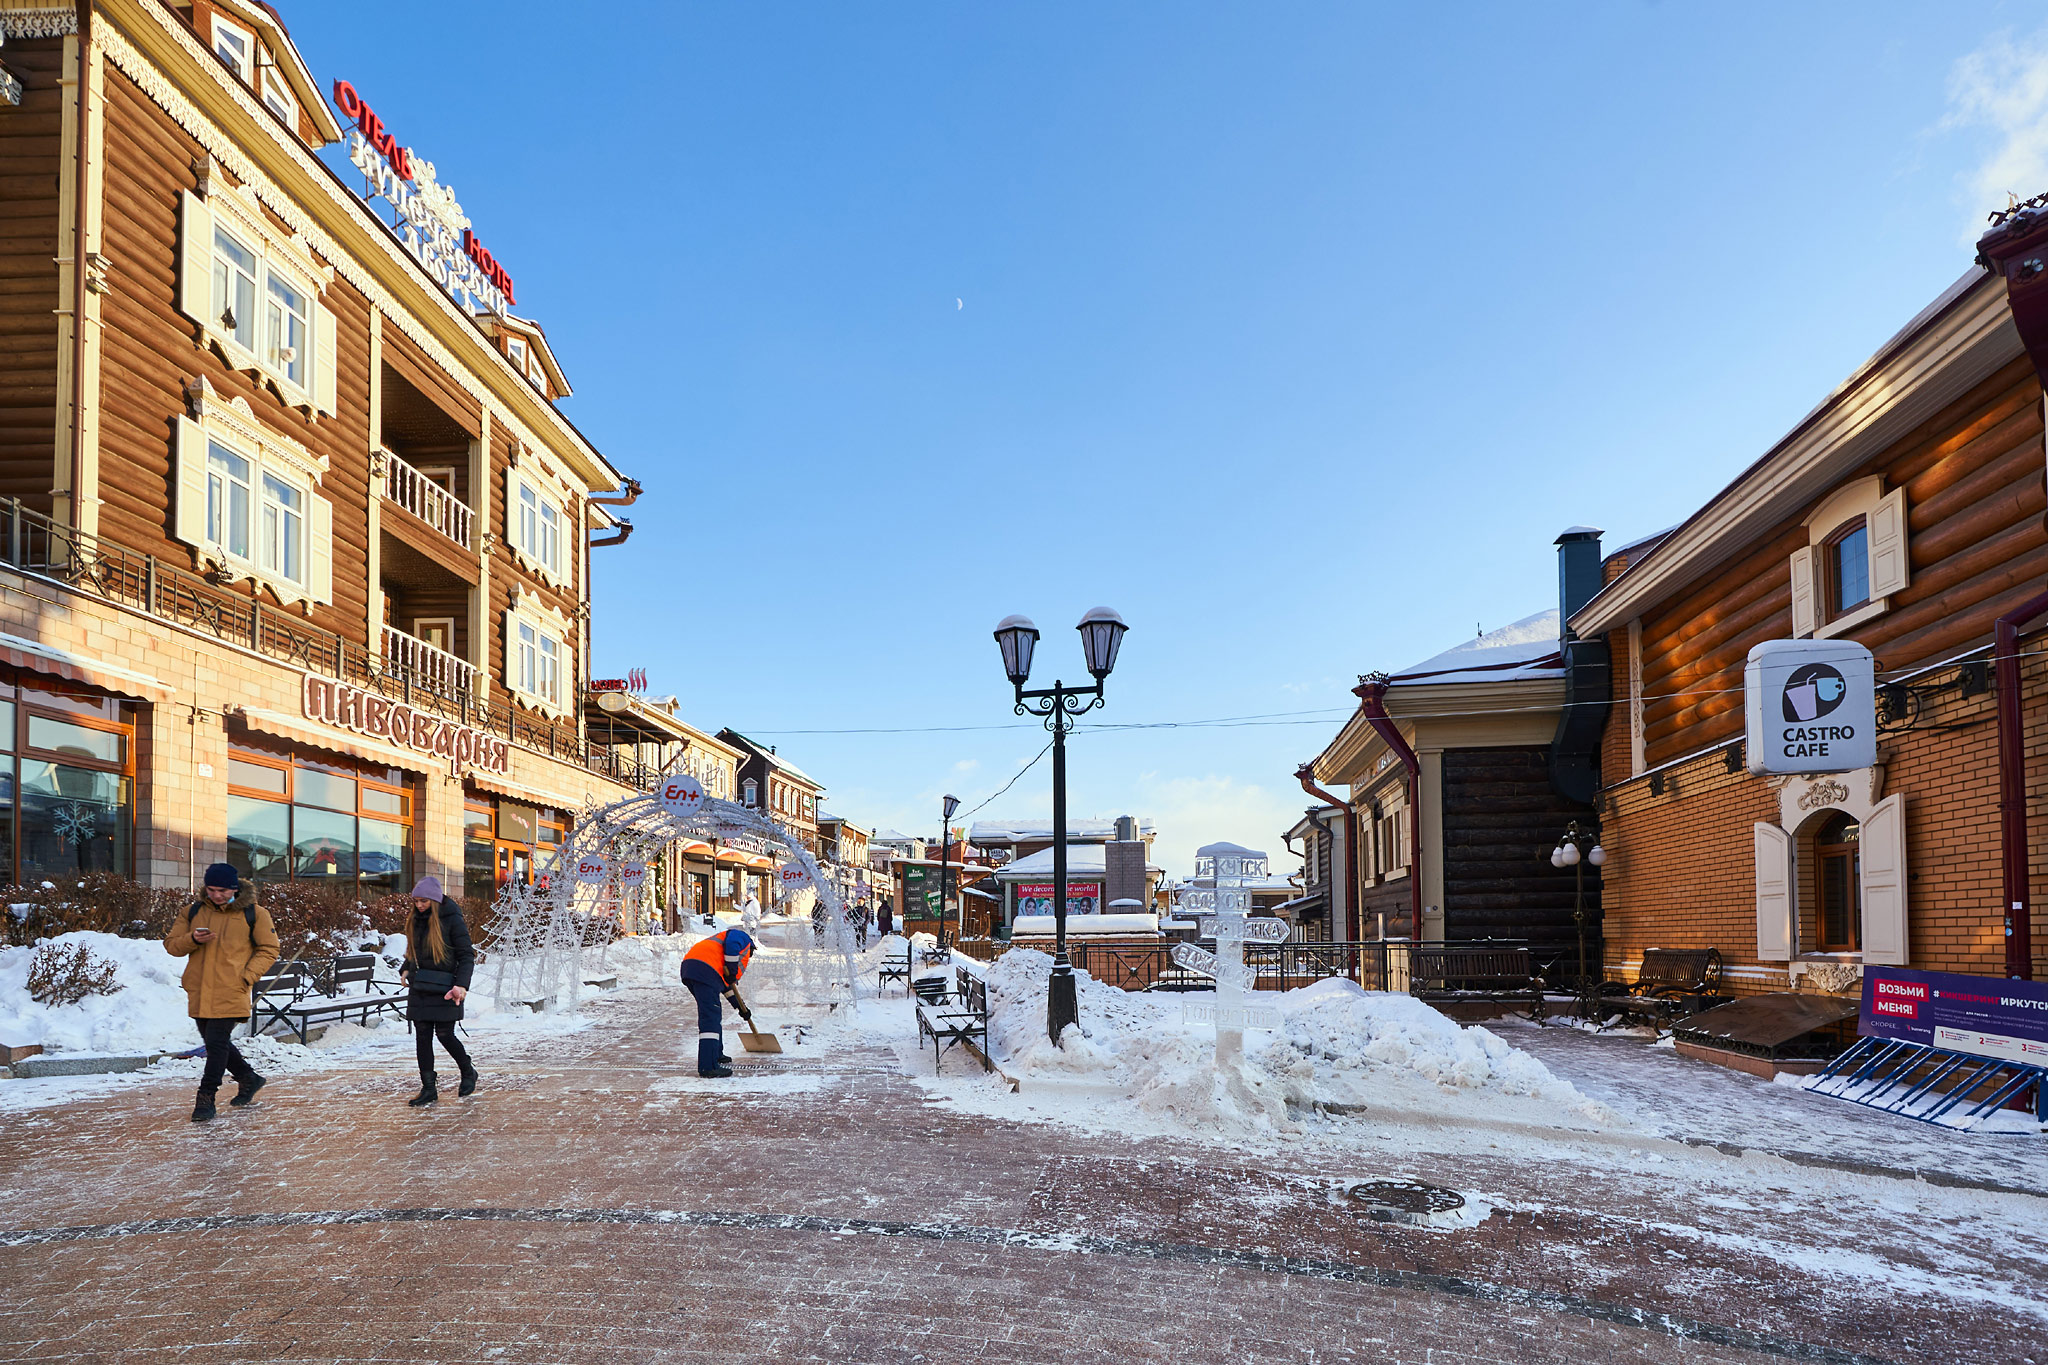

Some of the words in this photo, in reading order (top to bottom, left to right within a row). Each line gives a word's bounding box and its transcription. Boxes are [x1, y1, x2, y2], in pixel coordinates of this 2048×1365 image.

[333, 79, 414, 181] ОТЕЛЬ
[463, 230, 517, 306] HOTEL
[305, 674, 509, 777] ПИВОВАРНЯ
[1782, 725, 1855, 742] CASTRO
[1783, 743, 1829, 757] CAFE
[665, 785, 699, 801] En+
[1197, 860, 1264, 876] ИРКУТСК
[1878, 983, 1924, 998] ВОЗЬМИ
[1877, 1001, 1913, 1015] МЕНЯ!
[1979, 1037, 1985, 1045] 2
[2021, 1044, 2027, 1052] 3
